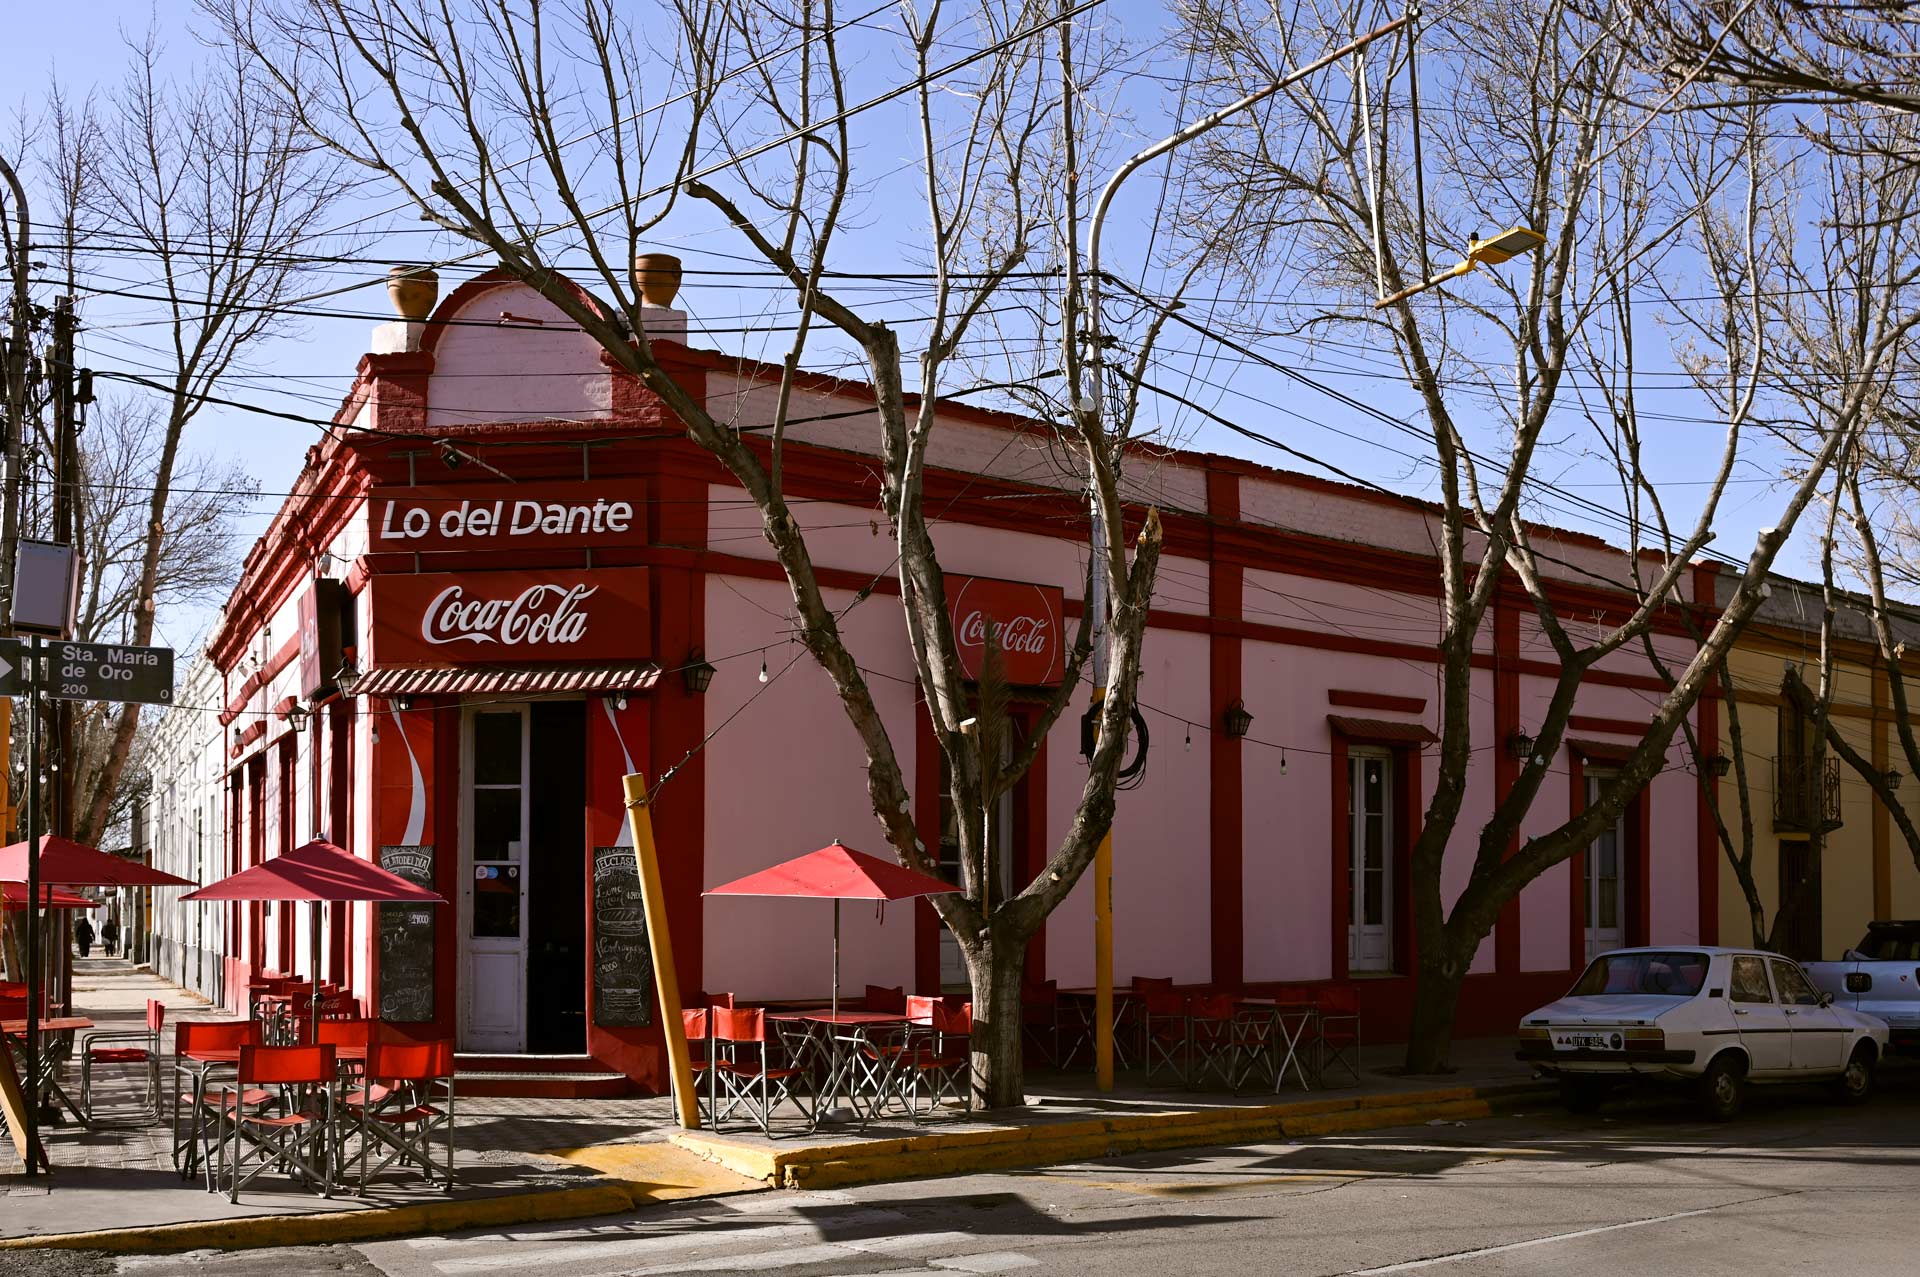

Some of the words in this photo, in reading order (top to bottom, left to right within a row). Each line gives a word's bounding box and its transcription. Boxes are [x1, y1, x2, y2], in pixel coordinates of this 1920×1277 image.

[380, 500, 431, 539] Lo
[439, 500, 504, 538] del
[509, 498, 633, 536] Dante
[421, 583, 600, 645] Coca-Cola
[61, 645, 98, 662] Sta.
[107, 648, 158, 666] María
[61, 663, 86, 678] de
[98, 664, 133, 681] Oro
[61, 683, 89, 695] 200
